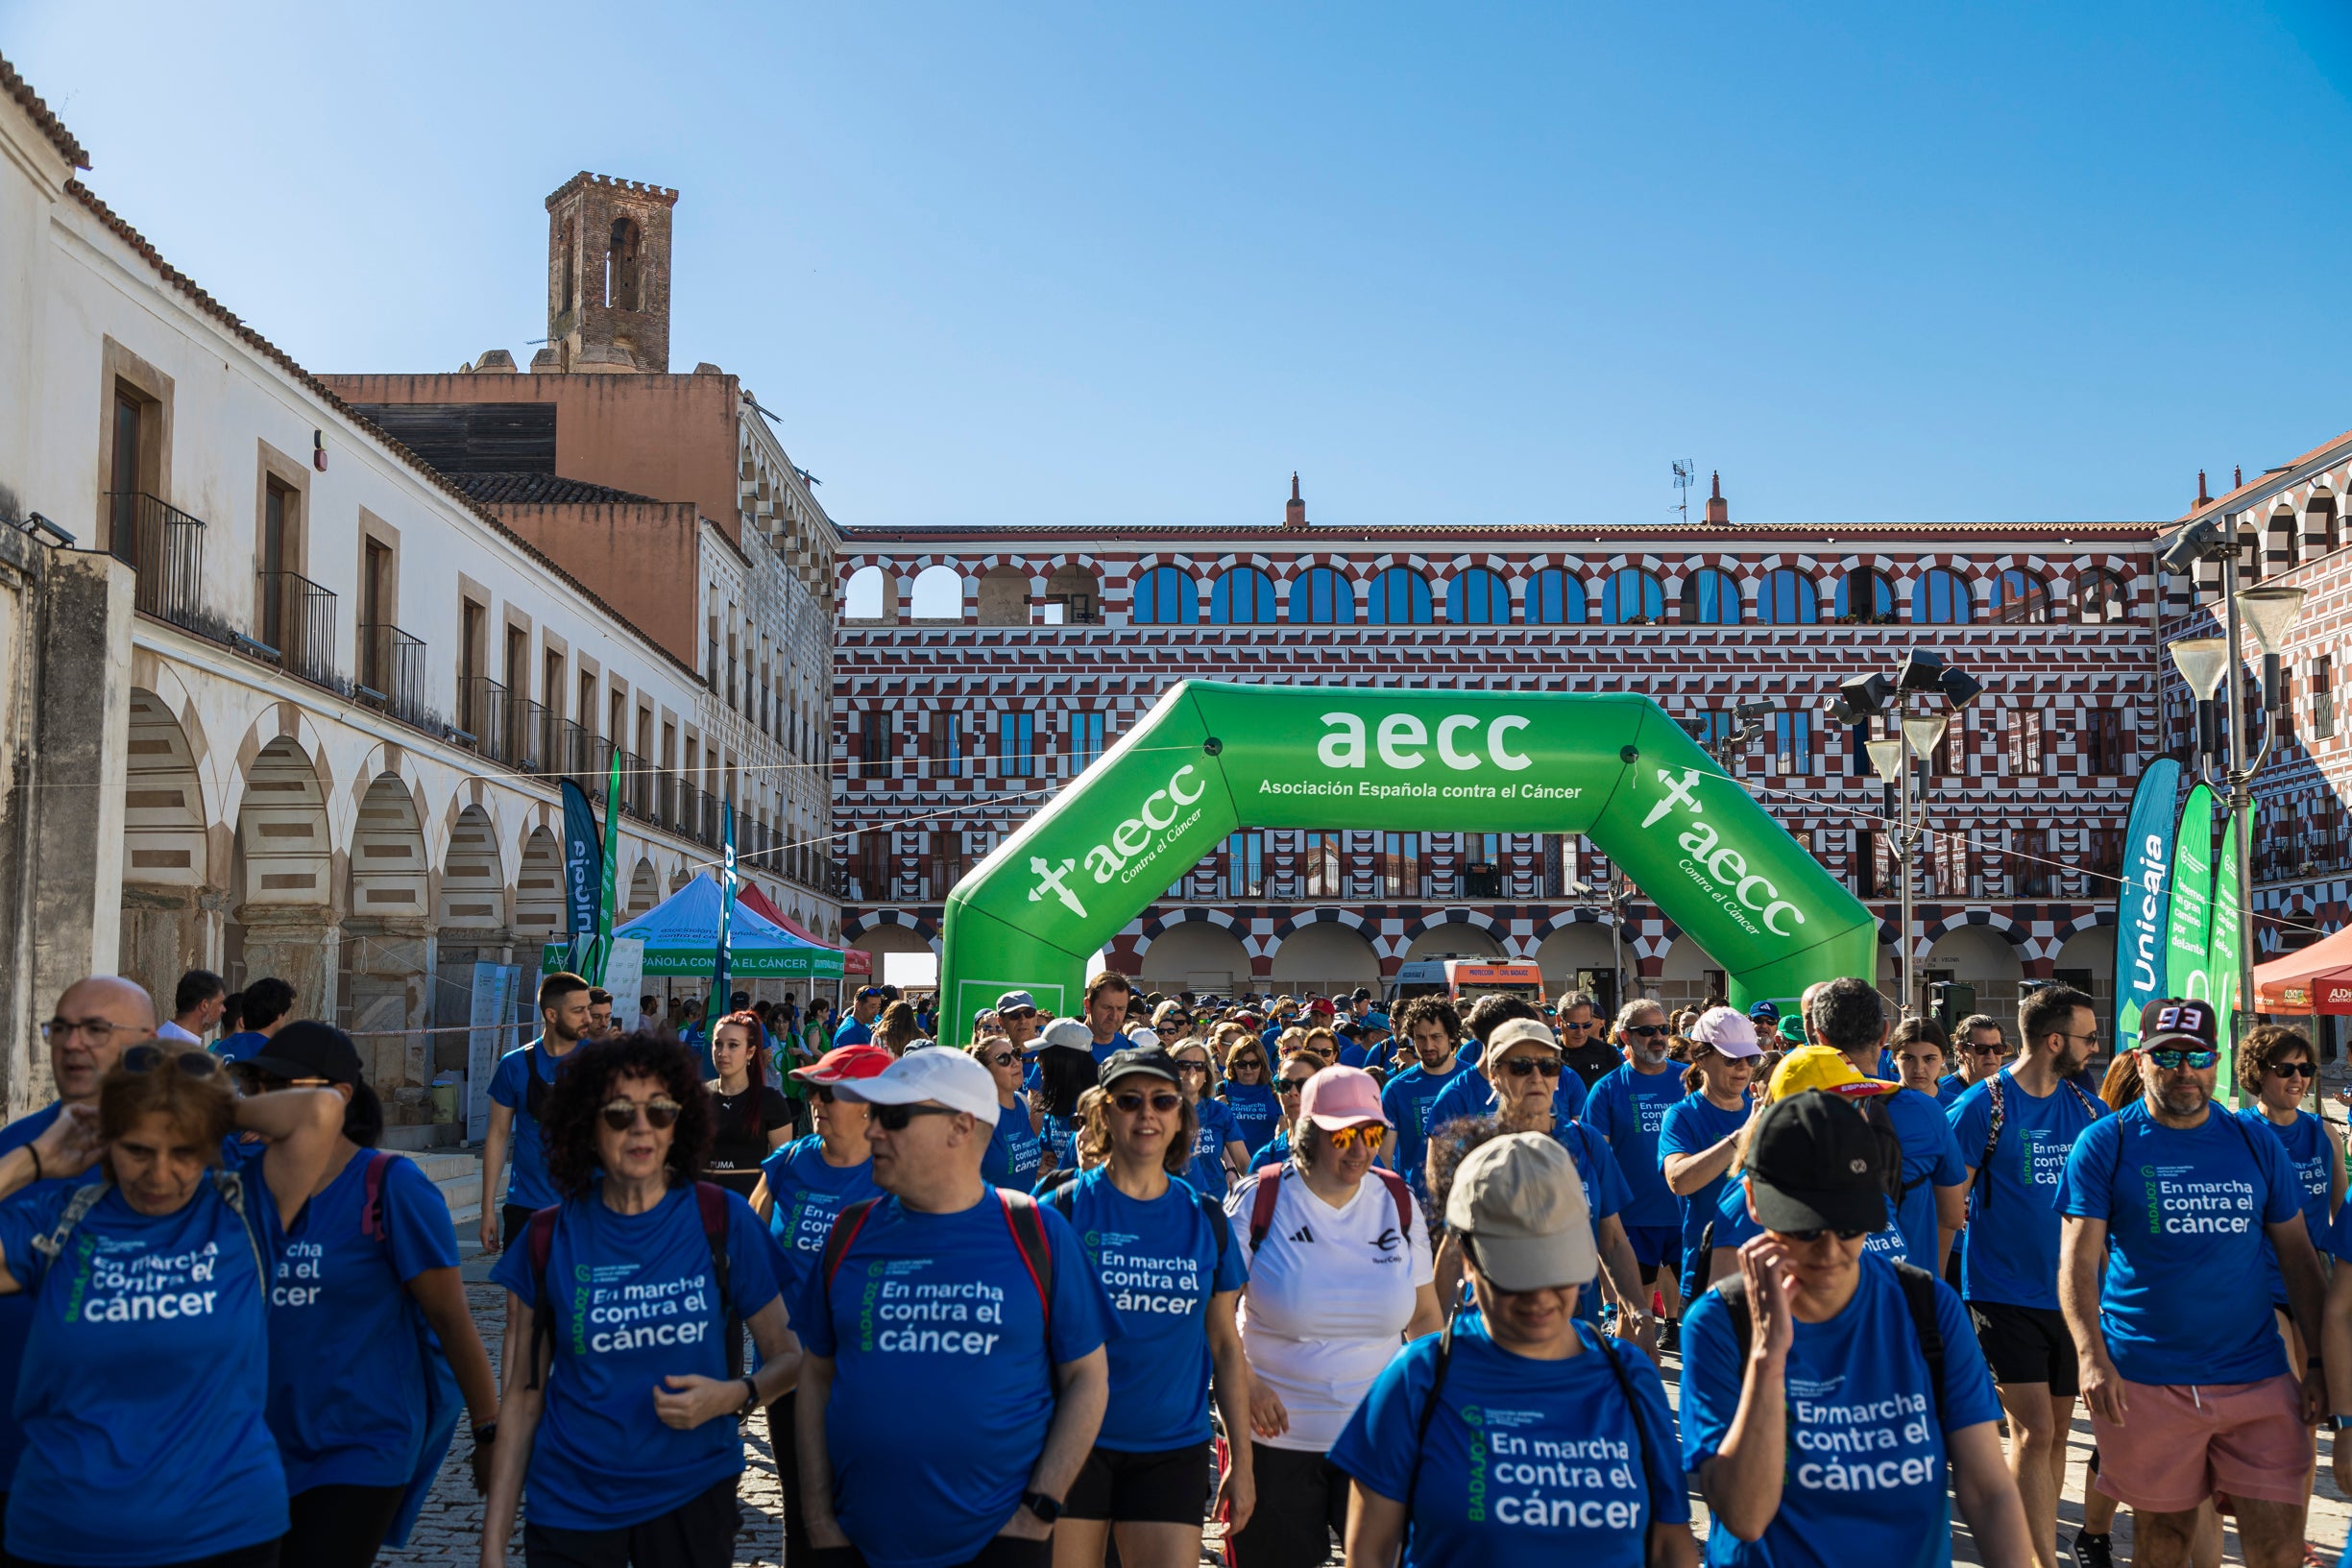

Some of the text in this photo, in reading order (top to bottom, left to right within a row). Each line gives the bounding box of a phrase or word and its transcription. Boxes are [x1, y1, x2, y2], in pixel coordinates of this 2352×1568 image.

[1317, 712, 1534, 771] aecc
[1259, 780, 1582, 799] Asociación Española contra el Cáncer
[1084, 764, 1205, 884] aecc
[1121, 808, 1202, 884] Contra el Cáncer
[1678, 822, 1806, 937] aecc
[2177, 876, 2206, 905] Tenemos
[1679, 859, 1760, 935] Contra el Cáncer
[2184, 900, 2200, 915] gran
[2133, 834, 2166, 992] Unicaja
[2174, 907, 2201, 928] camino
[2173, 922, 2186, 934] por
[2171, 935, 2205, 956] delante
[643, 954, 688, 967] PAÑOLA
[742, 958, 756, 968] EL
[759, 956, 808, 969] CÁNCER
[2156, 1006, 2202, 1030] 93
[1841, 1082, 1879, 1092] ESPAÑA
[2033, 1143, 2073, 1154] En mar
[710, 1160, 735, 1169] PUMA
[1015, 1156, 1042, 1173] cánce
[2161, 1179, 2253, 1194] En marcha
[804, 1204, 823, 1218] En
[2148, 1181, 2161, 1234] BADAJOZ
[2164, 1194, 2253, 1211] contra el
[2166, 1213, 2251, 1234] cáncer
[1891, 1232, 1904, 1248] el
[191, 1256, 214, 1282] el
[296, 1258, 321, 1279] el
[1103, 1251, 1125, 1266] En
[1129, 1256, 1198, 1271] marcha
[594, 1275, 706, 1305] En marcha
[882, 1281, 1005, 1302] En marcha
[1102, 1270, 1199, 1291] contra el
[84, 1290, 218, 1323] cáncer
[591, 1291, 708, 1324] contra el
[880, 1300, 1003, 1325] contra el
[1108, 1289, 1198, 1315] áncer
[861, 1281, 880, 1352] BADAJOZ
[592, 1321, 709, 1353] cáncer
[879, 1324, 1000, 1355] cáncer
[1796, 1393, 1927, 1425] En marcha
[1491, 1432, 1630, 1460] En marcha
[1796, 1414, 1930, 1454] contra el
[1468, 1429, 1487, 1522] BADAJOZ
[1494, 1461, 1637, 1489] contra el
[1797, 1456, 1935, 1491] cáncer
[1494, 1489, 1641, 1530] cáncer
